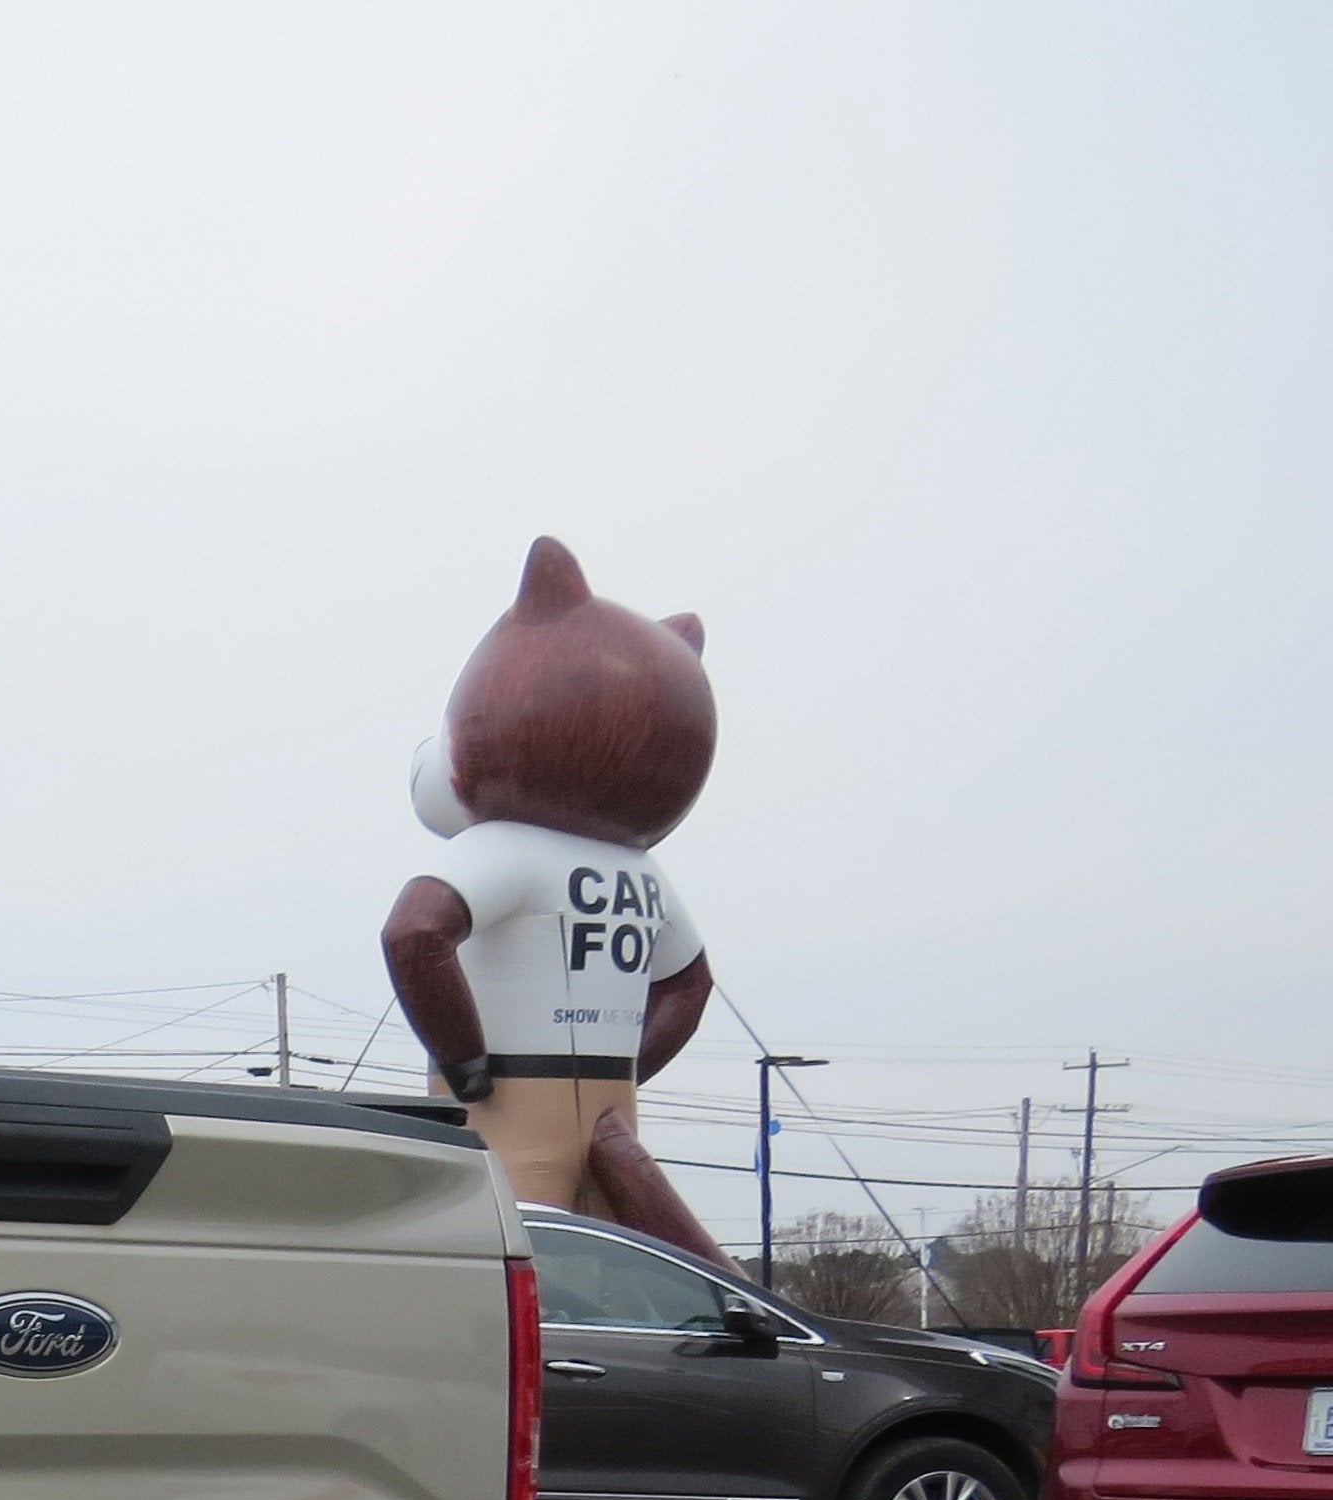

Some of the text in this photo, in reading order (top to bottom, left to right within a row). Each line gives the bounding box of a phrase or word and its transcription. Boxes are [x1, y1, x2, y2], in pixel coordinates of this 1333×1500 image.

[568, 866, 665, 920] CAR
[553, 1009, 600, 1024] SHOW
[0, 1309, 87, 1357] Ford
[1121, 1341, 1167, 1352] XT4
